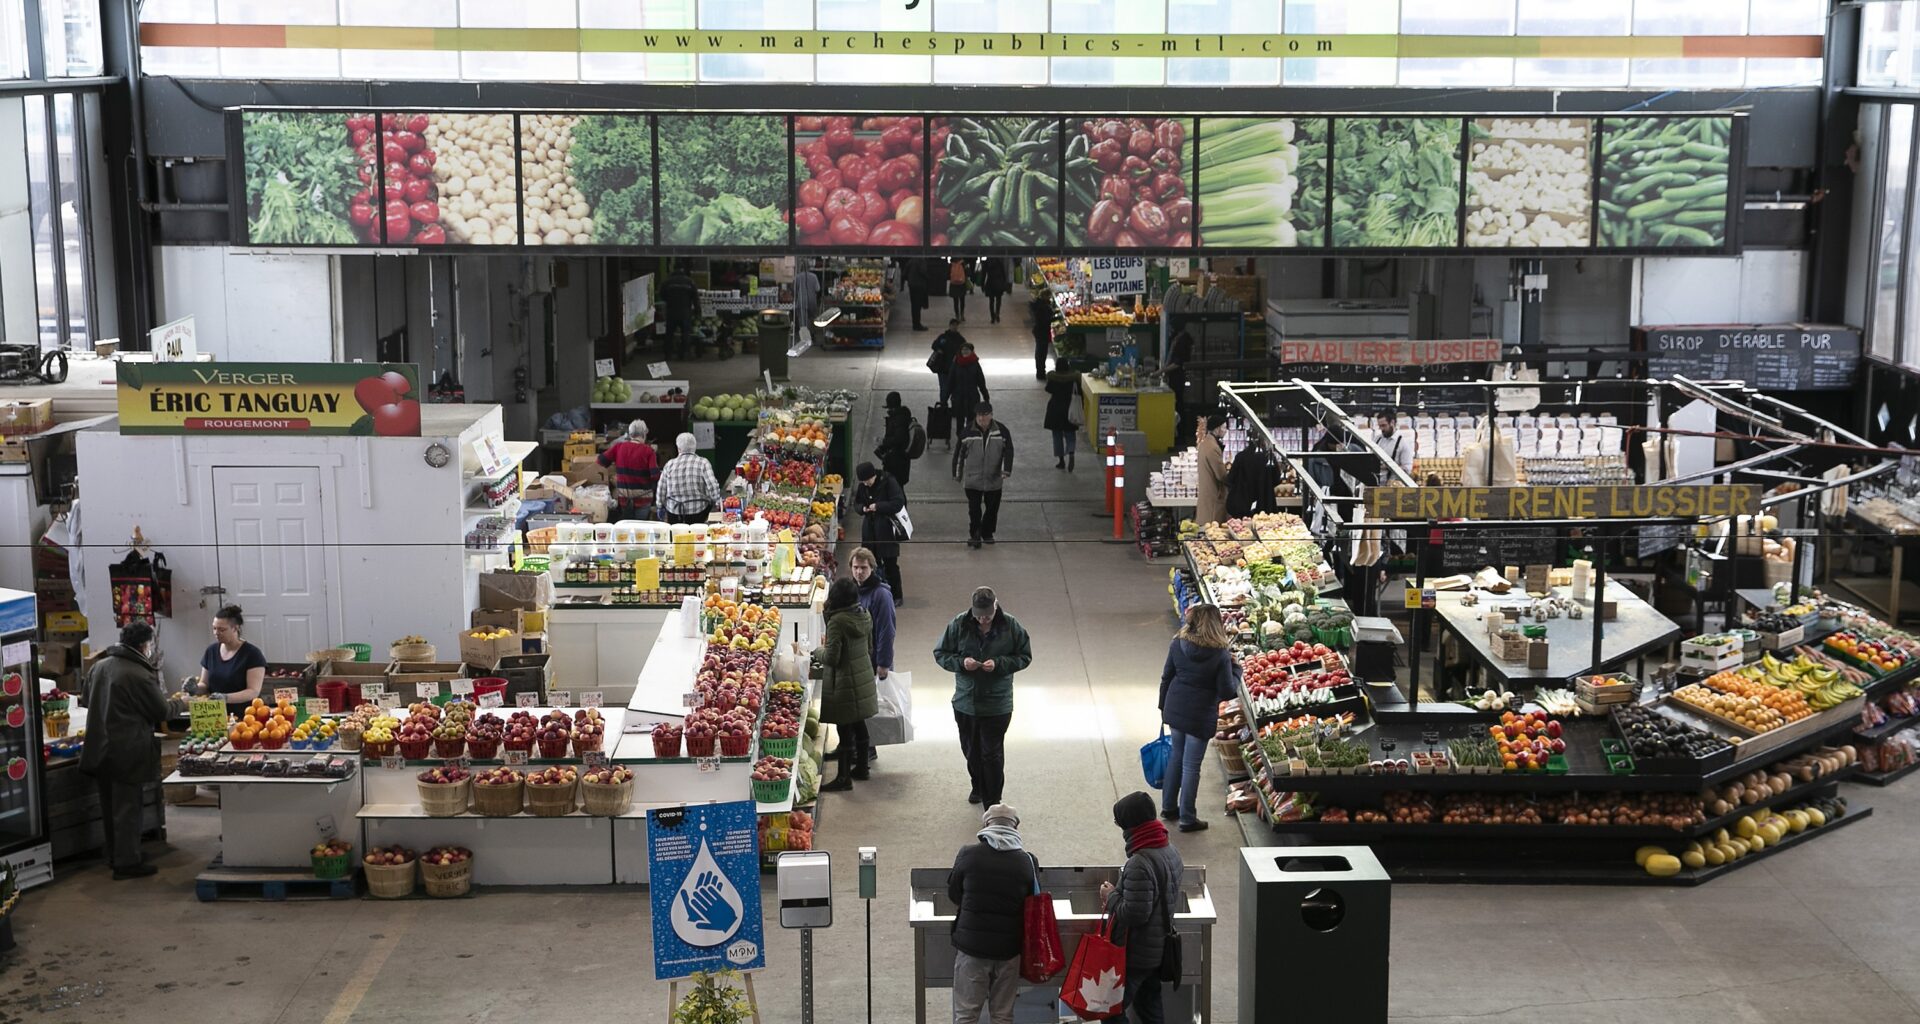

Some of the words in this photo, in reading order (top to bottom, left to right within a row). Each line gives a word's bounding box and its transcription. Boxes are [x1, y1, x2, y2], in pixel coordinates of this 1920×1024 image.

[644, 32, 1332, 54] www.marchespublics-mtl.com
[1094, 258, 1111, 269] LES
[1114, 256, 1143, 268] OEUFS
[1111, 270, 1127, 279] DU
[1095, 280, 1144, 294] CAPITAINE
[1659, 334, 1704, 350] SIROP
[1719, 332, 1786, 349] D'ÉRABLE
[1800, 333, 1832, 349] PUR
[1281, 341, 1401, 364] ERABLIERE
[1411, 340, 1500, 364] LUSSIER
[192, 368, 298, 385] VERGER
[150, 387, 211, 412] ÉRIC
[219, 392, 341, 414] TANGUAY
[203, 420, 291, 429] ROUGEMONT
[1372, 487, 1491, 518] FERME
[1508, 486, 1598, 518] RENE
[1609, 485, 1753, 517] LUSSIER
